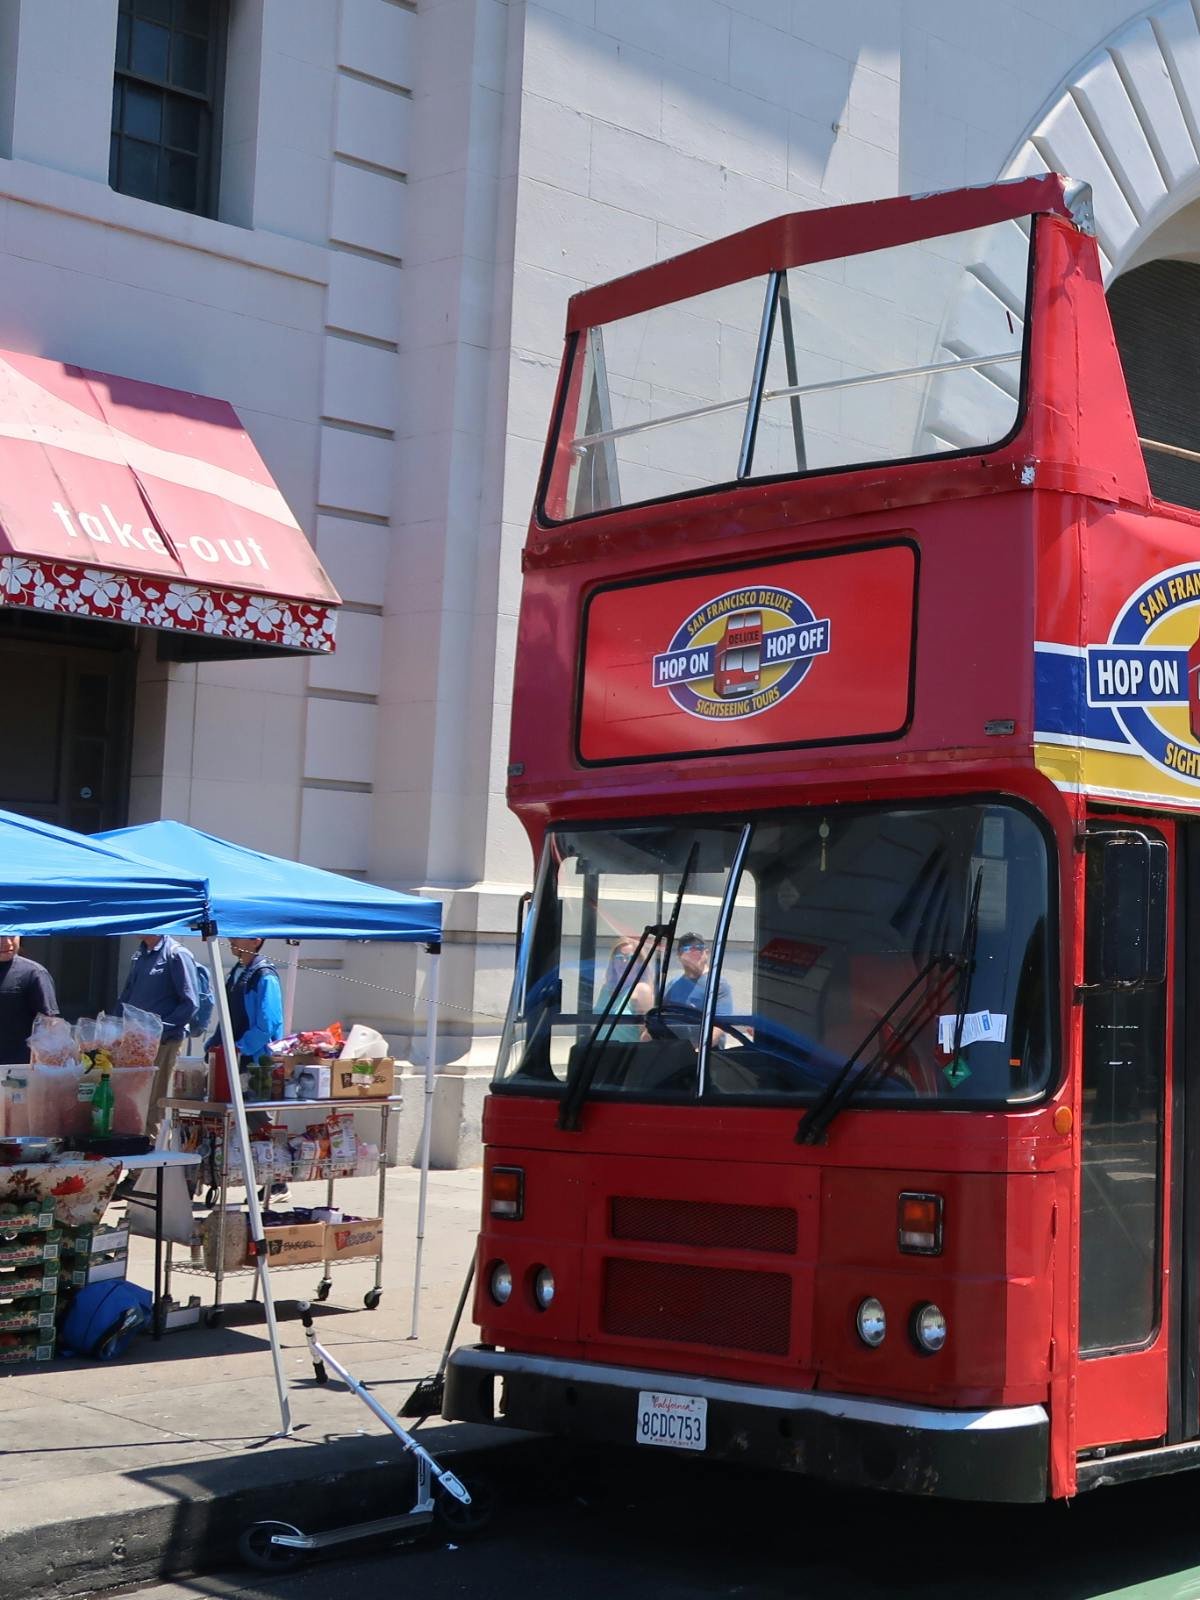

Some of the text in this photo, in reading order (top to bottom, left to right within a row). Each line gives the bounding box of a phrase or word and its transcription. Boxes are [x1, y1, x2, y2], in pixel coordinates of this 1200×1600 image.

[52, 500, 271, 570] take-out
[687, 591, 793, 636] SAN FRANCISCO DELUXE
[1139, 588, 1168, 625] SAN
[728, 630, 759, 645] DELUXE
[767, 627, 824, 659] HOP OFF
[659, 651, 709, 681] HOP ON
[1097, 659, 1179, 695] HOP ON
[696, 686, 780, 717] SIGHTSEEING TOURS
[642, 1412, 701, 1442] 8CDC753
